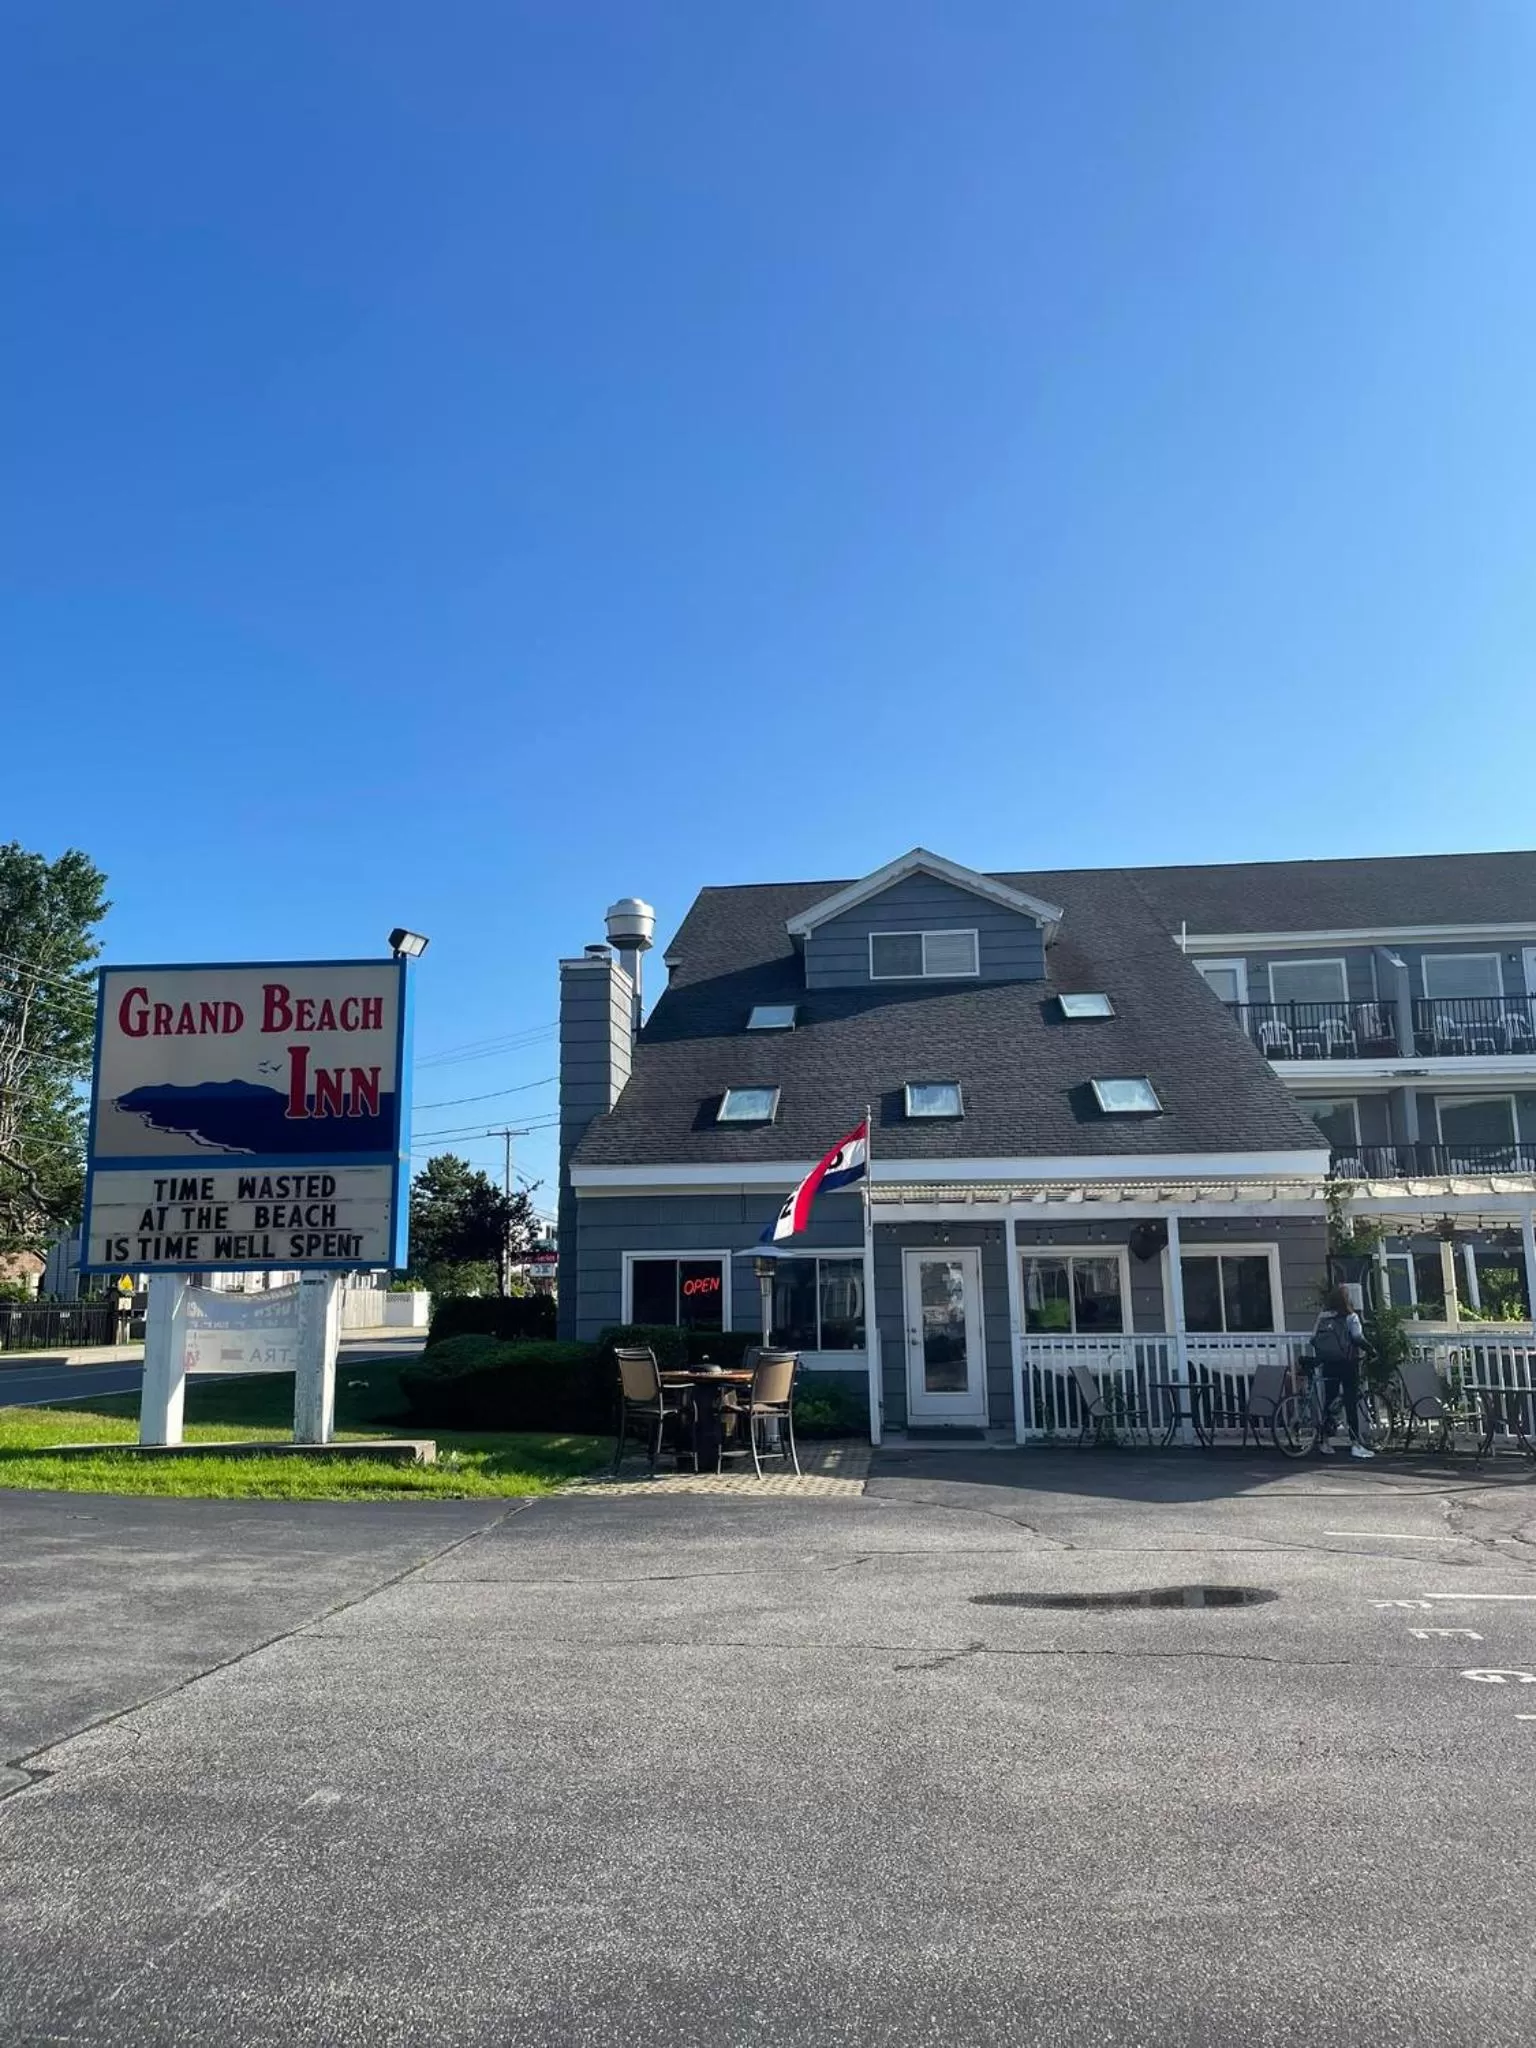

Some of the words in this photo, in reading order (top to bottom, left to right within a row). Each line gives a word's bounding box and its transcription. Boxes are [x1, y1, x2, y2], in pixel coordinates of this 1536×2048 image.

[118, 986, 244, 1037] GRAND
[260, 983, 384, 1032] BEACH
[286, 1047, 381, 1117] INN
[154, 1177, 215, 1201] TIME
[237, 1175, 336, 1199] WASTED
[138, 1206, 169, 1231] AT
[181, 1206, 229, 1230] THE
[254, 1204, 336, 1228] BEACH
[106, 1238, 129, 1261] IS
[137, 1236, 198, 1260] TIME
[214, 1235, 275, 1259] WELL
[290, 1234, 364, 1258] SPENT
[683, 1277, 720, 1296] OPEN
